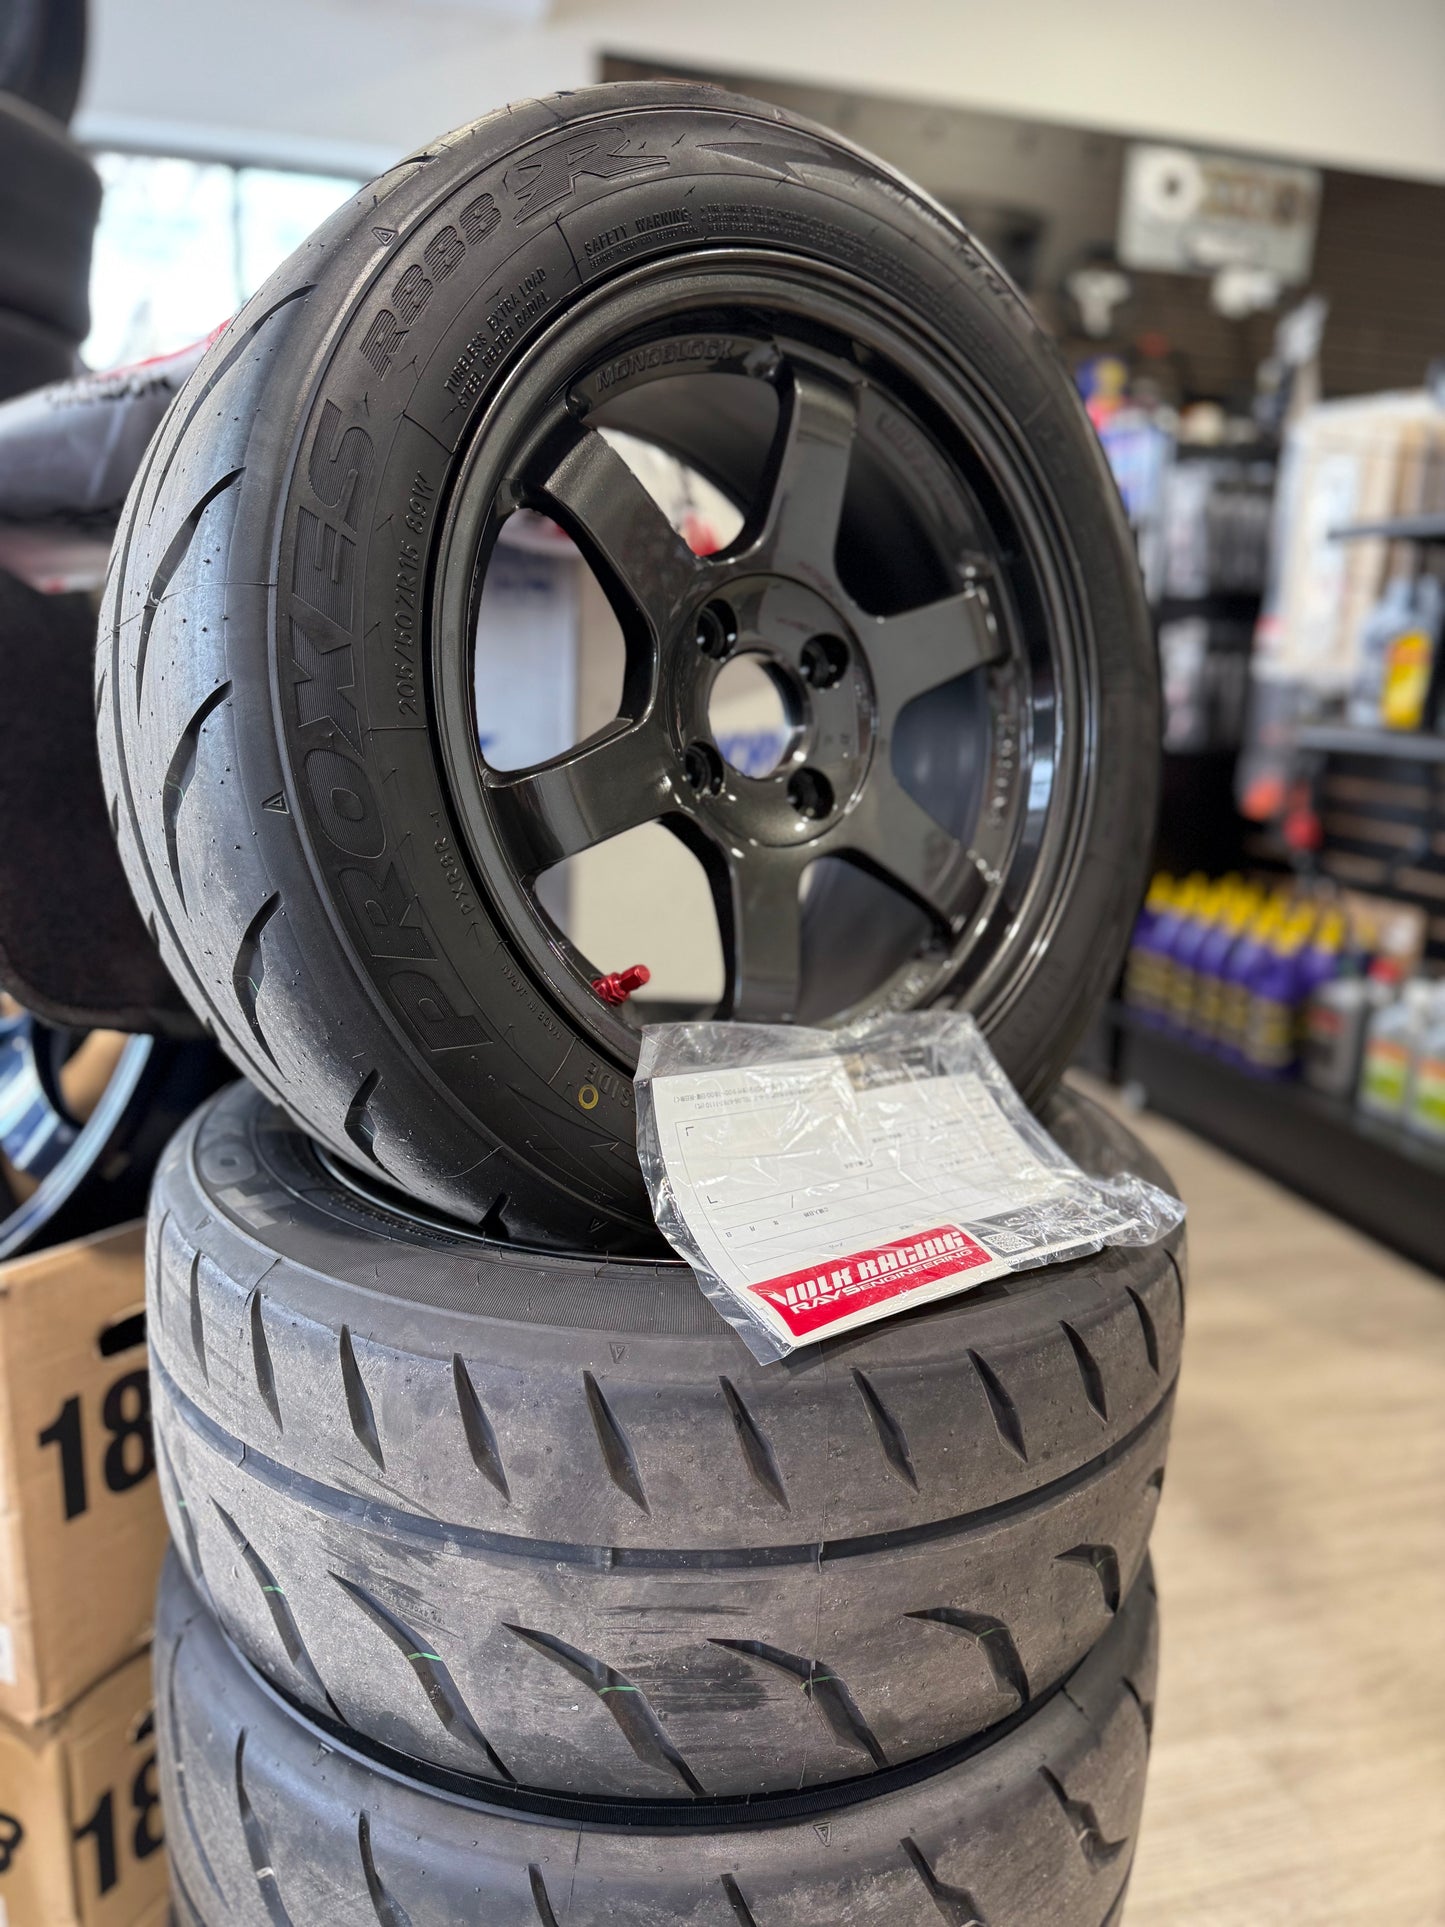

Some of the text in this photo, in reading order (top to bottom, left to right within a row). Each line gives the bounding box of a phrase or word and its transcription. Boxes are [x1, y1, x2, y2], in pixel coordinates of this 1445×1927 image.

[584, 222, 628, 257] SAFETY
[443, 266, 547, 397] TUBELESS EXTRA LOAD
[456, 290, 551, 411] STEEL BELTED RADIAL
[593, 338, 735, 393] MONOBLOCK
[404, 470, 434, 535] 89W
[289, 398, 494, 1052] PROXES
[433, 836, 475, 916] PXR8R
[501, 963, 529, 998] JAPAN
[759, 1230, 966, 1306] VOLK RACING
[37, 1368, 157, 1525] 18
